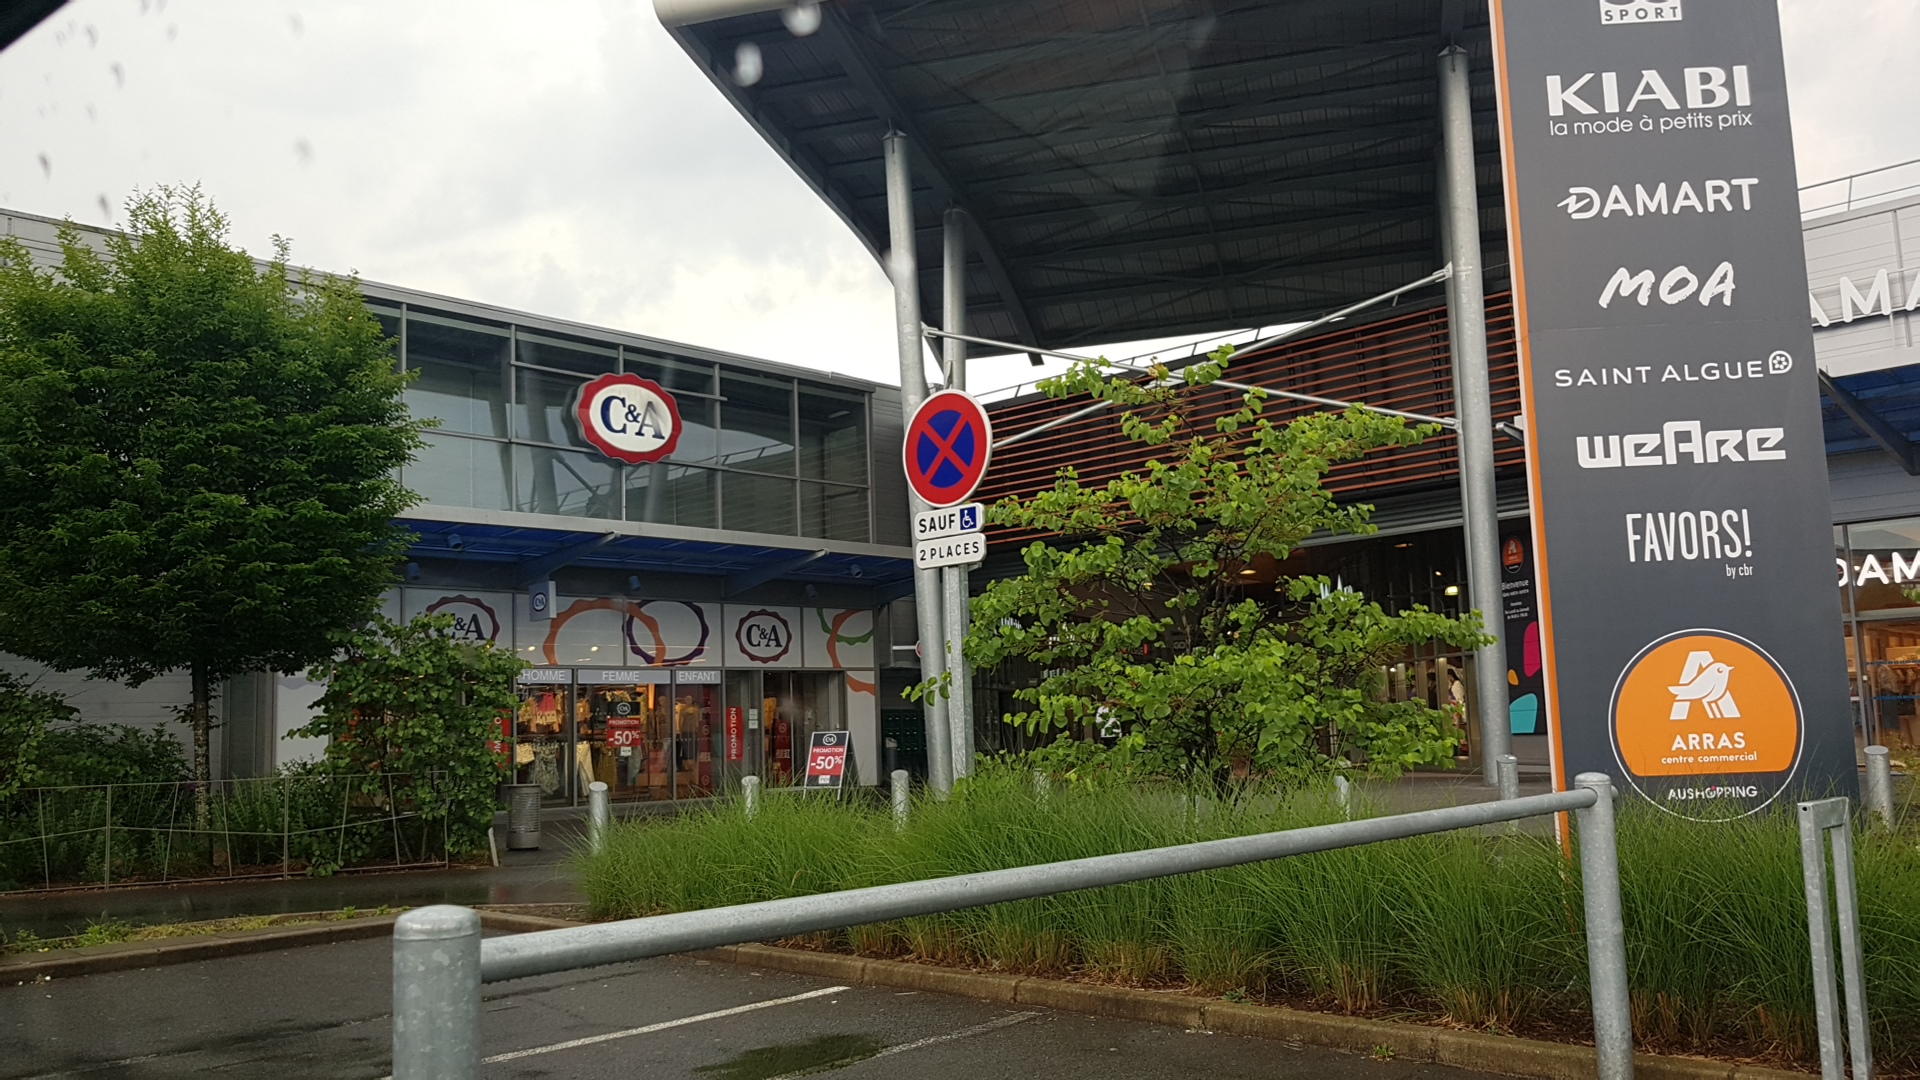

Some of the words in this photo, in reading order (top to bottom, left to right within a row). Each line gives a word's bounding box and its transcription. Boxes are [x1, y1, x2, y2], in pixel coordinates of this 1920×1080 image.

[1604, 6, 1678, 22] SPORT
[1546, 65, 1752, 116] KIABI
[1550, 120, 1568, 136] la
[1574, 117, 1633, 135] mode
[1639, 114, 1653, 131] à
[1660, 113, 1713, 134] petits
[1718, 111, 1753, 131] prix
[1557, 177, 1759, 220] DAMART
[1598, 261, 1736, 309] MOA
[1555, 366, 1652, 387] SAINT
[1661, 360, 1764, 382] ALGUE
[600, 395, 666, 440] C&A
[918, 513, 956, 533] SAUF
[1626, 509, 1753, 562] FAVORS!
[919, 549, 927, 561] 2
[930, 541, 979, 560] PLACES
[1725, 563, 1736, 580] by
[1738, 563, 1753, 576] cbr
[746, 623, 783, 647] C&A
[522, 670, 566, 681] HOMME
[602, 670, 640, 682] FEMME
[678, 670, 717, 682] ENFANT
[608, 730, 641, 745] -50%
[730, 707, 738, 760] PROMOTION
[1671, 731, 1746, 751] ARRAS
[810, 755, 844, 770] -50%
[1661, 755, 1694, 764] centre
[1697, 750, 1758, 763] commercial
[1667, 785, 1758, 800] AUSHOPPING
